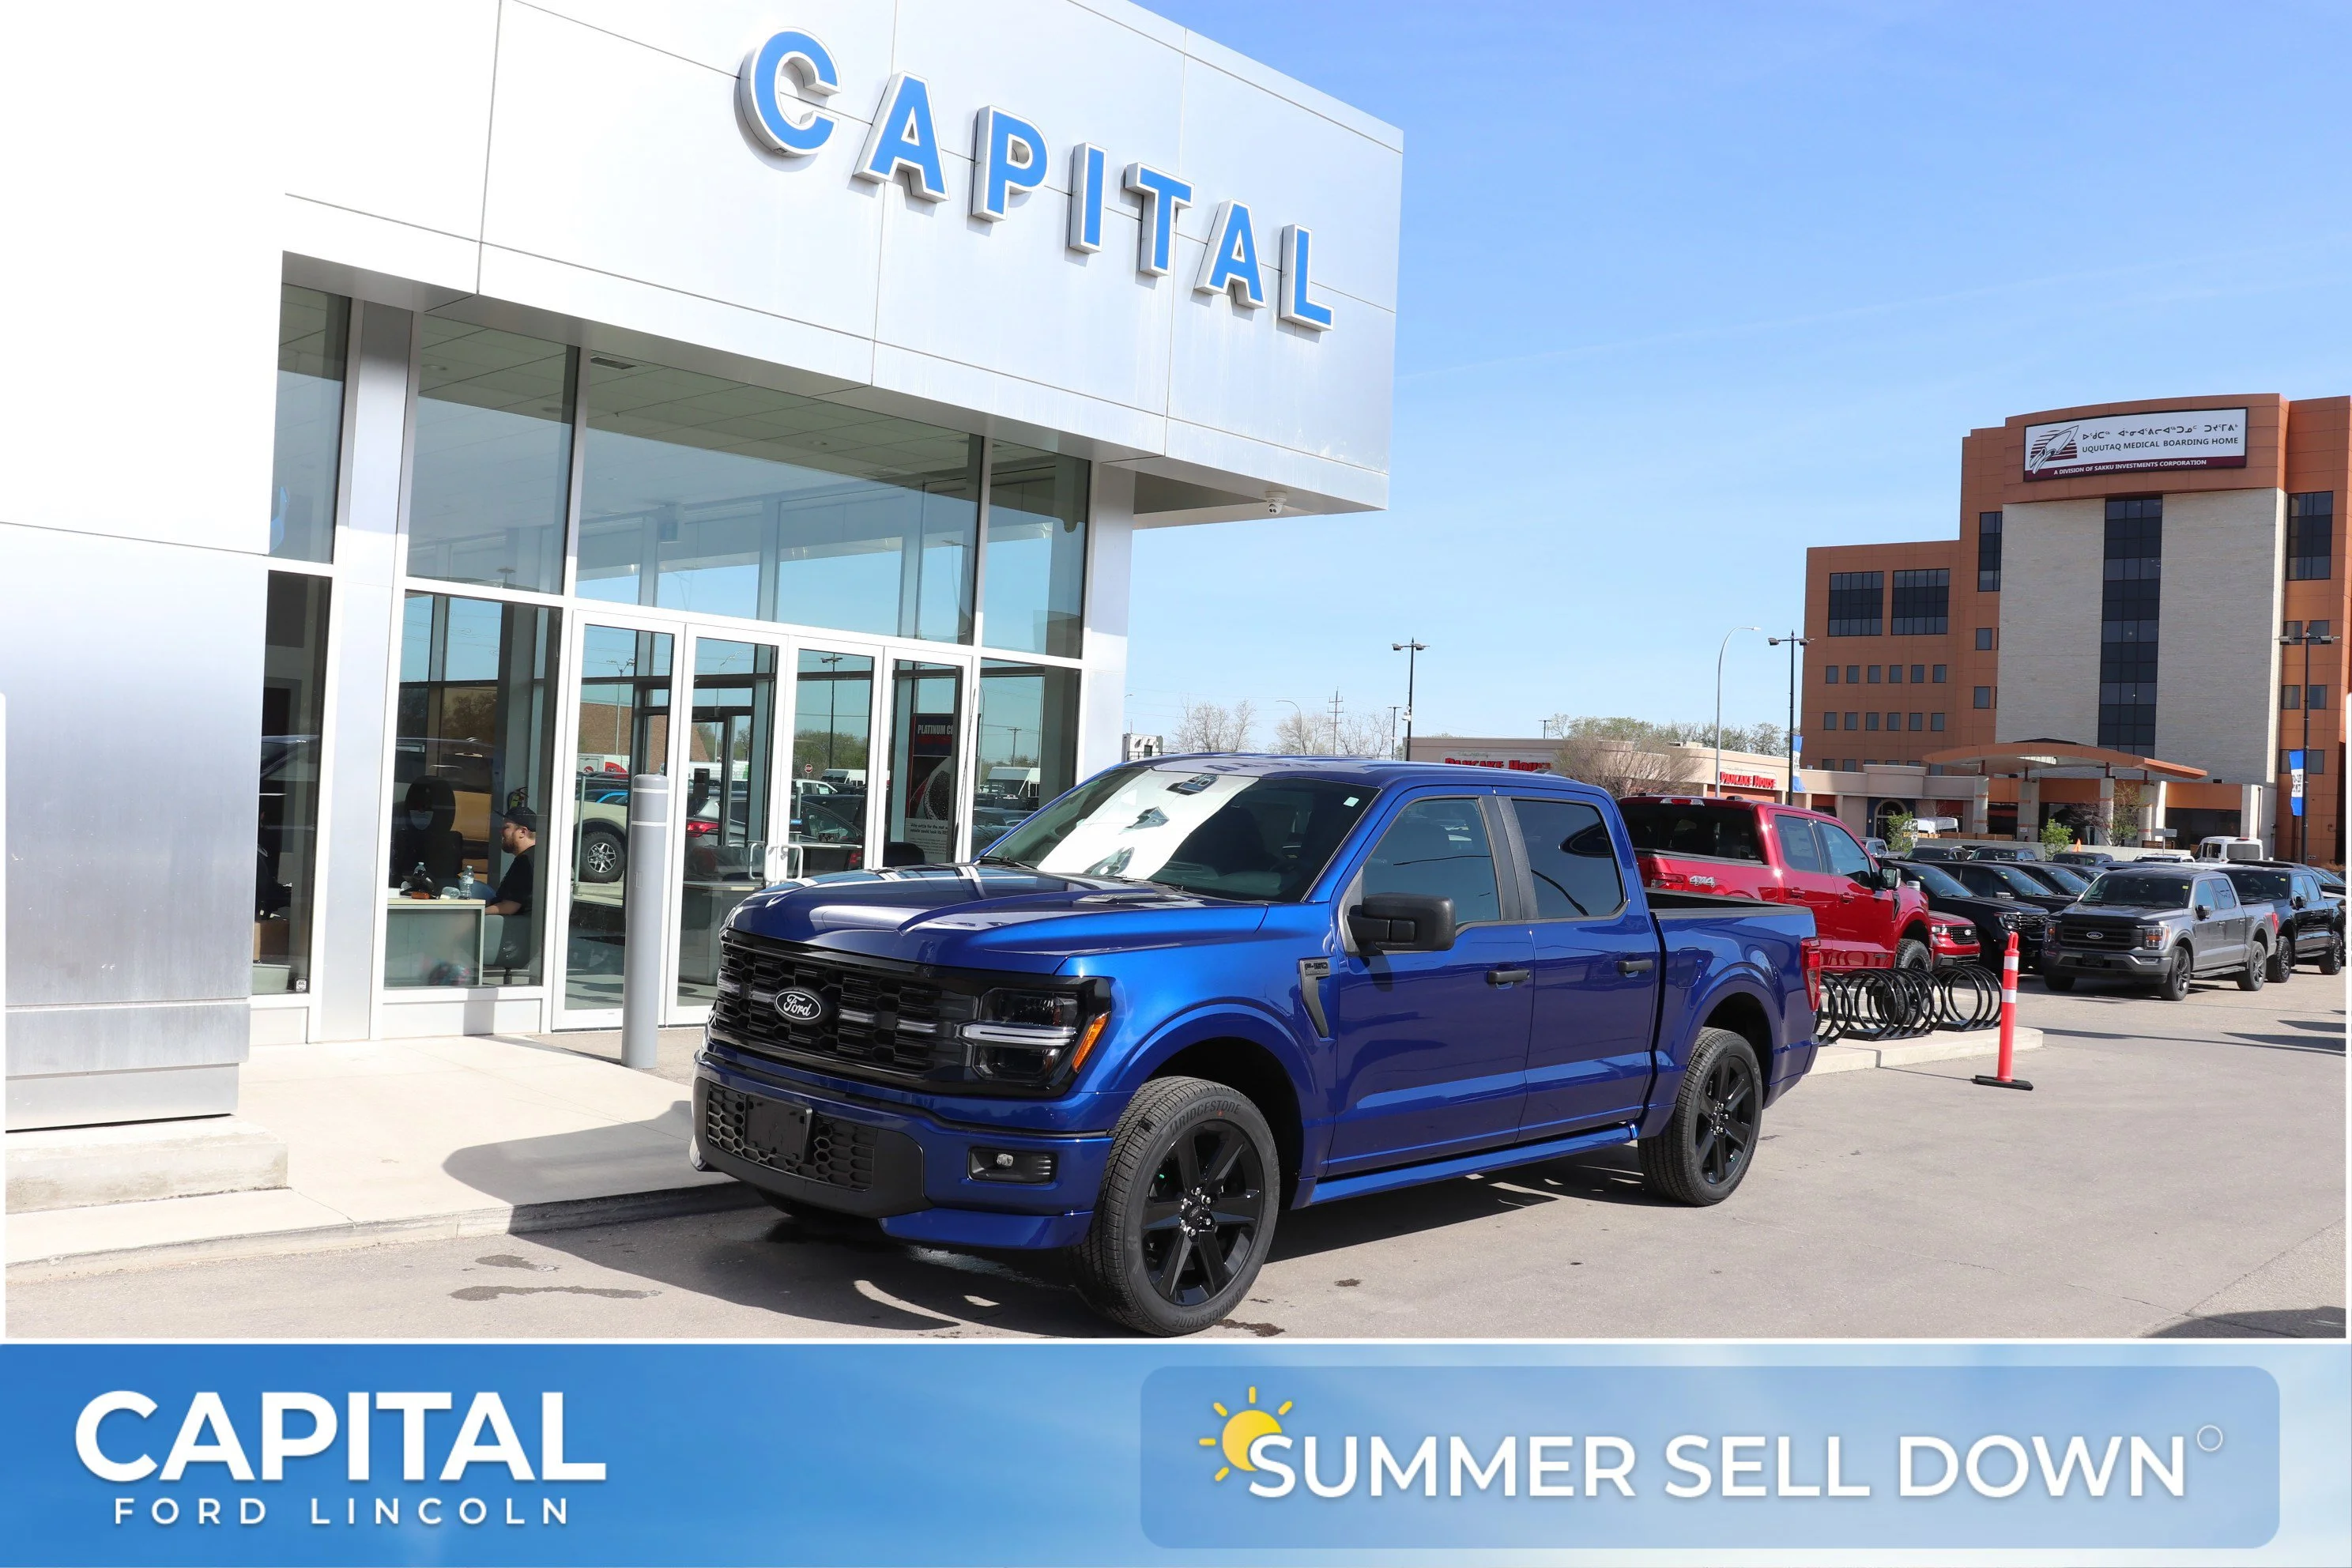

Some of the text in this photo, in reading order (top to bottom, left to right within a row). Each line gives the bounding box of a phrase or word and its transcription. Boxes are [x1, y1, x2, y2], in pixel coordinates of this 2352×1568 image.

[738, 26, 1334, 333] CAPITAL
[2082, 443, 2122, 453] UQUUTAQ
[2123, 440, 2160, 450] MEDICAL
[2163, 438, 2209, 447] BOARDING
[2115, 461, 2158, 469] INVESTMENTS
[918, 724, 946, 735] PLATINUM
[1753, 775, 1777, 790] HOUSE
[1304, 962, 1329, 971] F-150
[783, 994, 812, 1016] Ford
[1170, 1099, 1241, 1136] BRIDGESTONE
